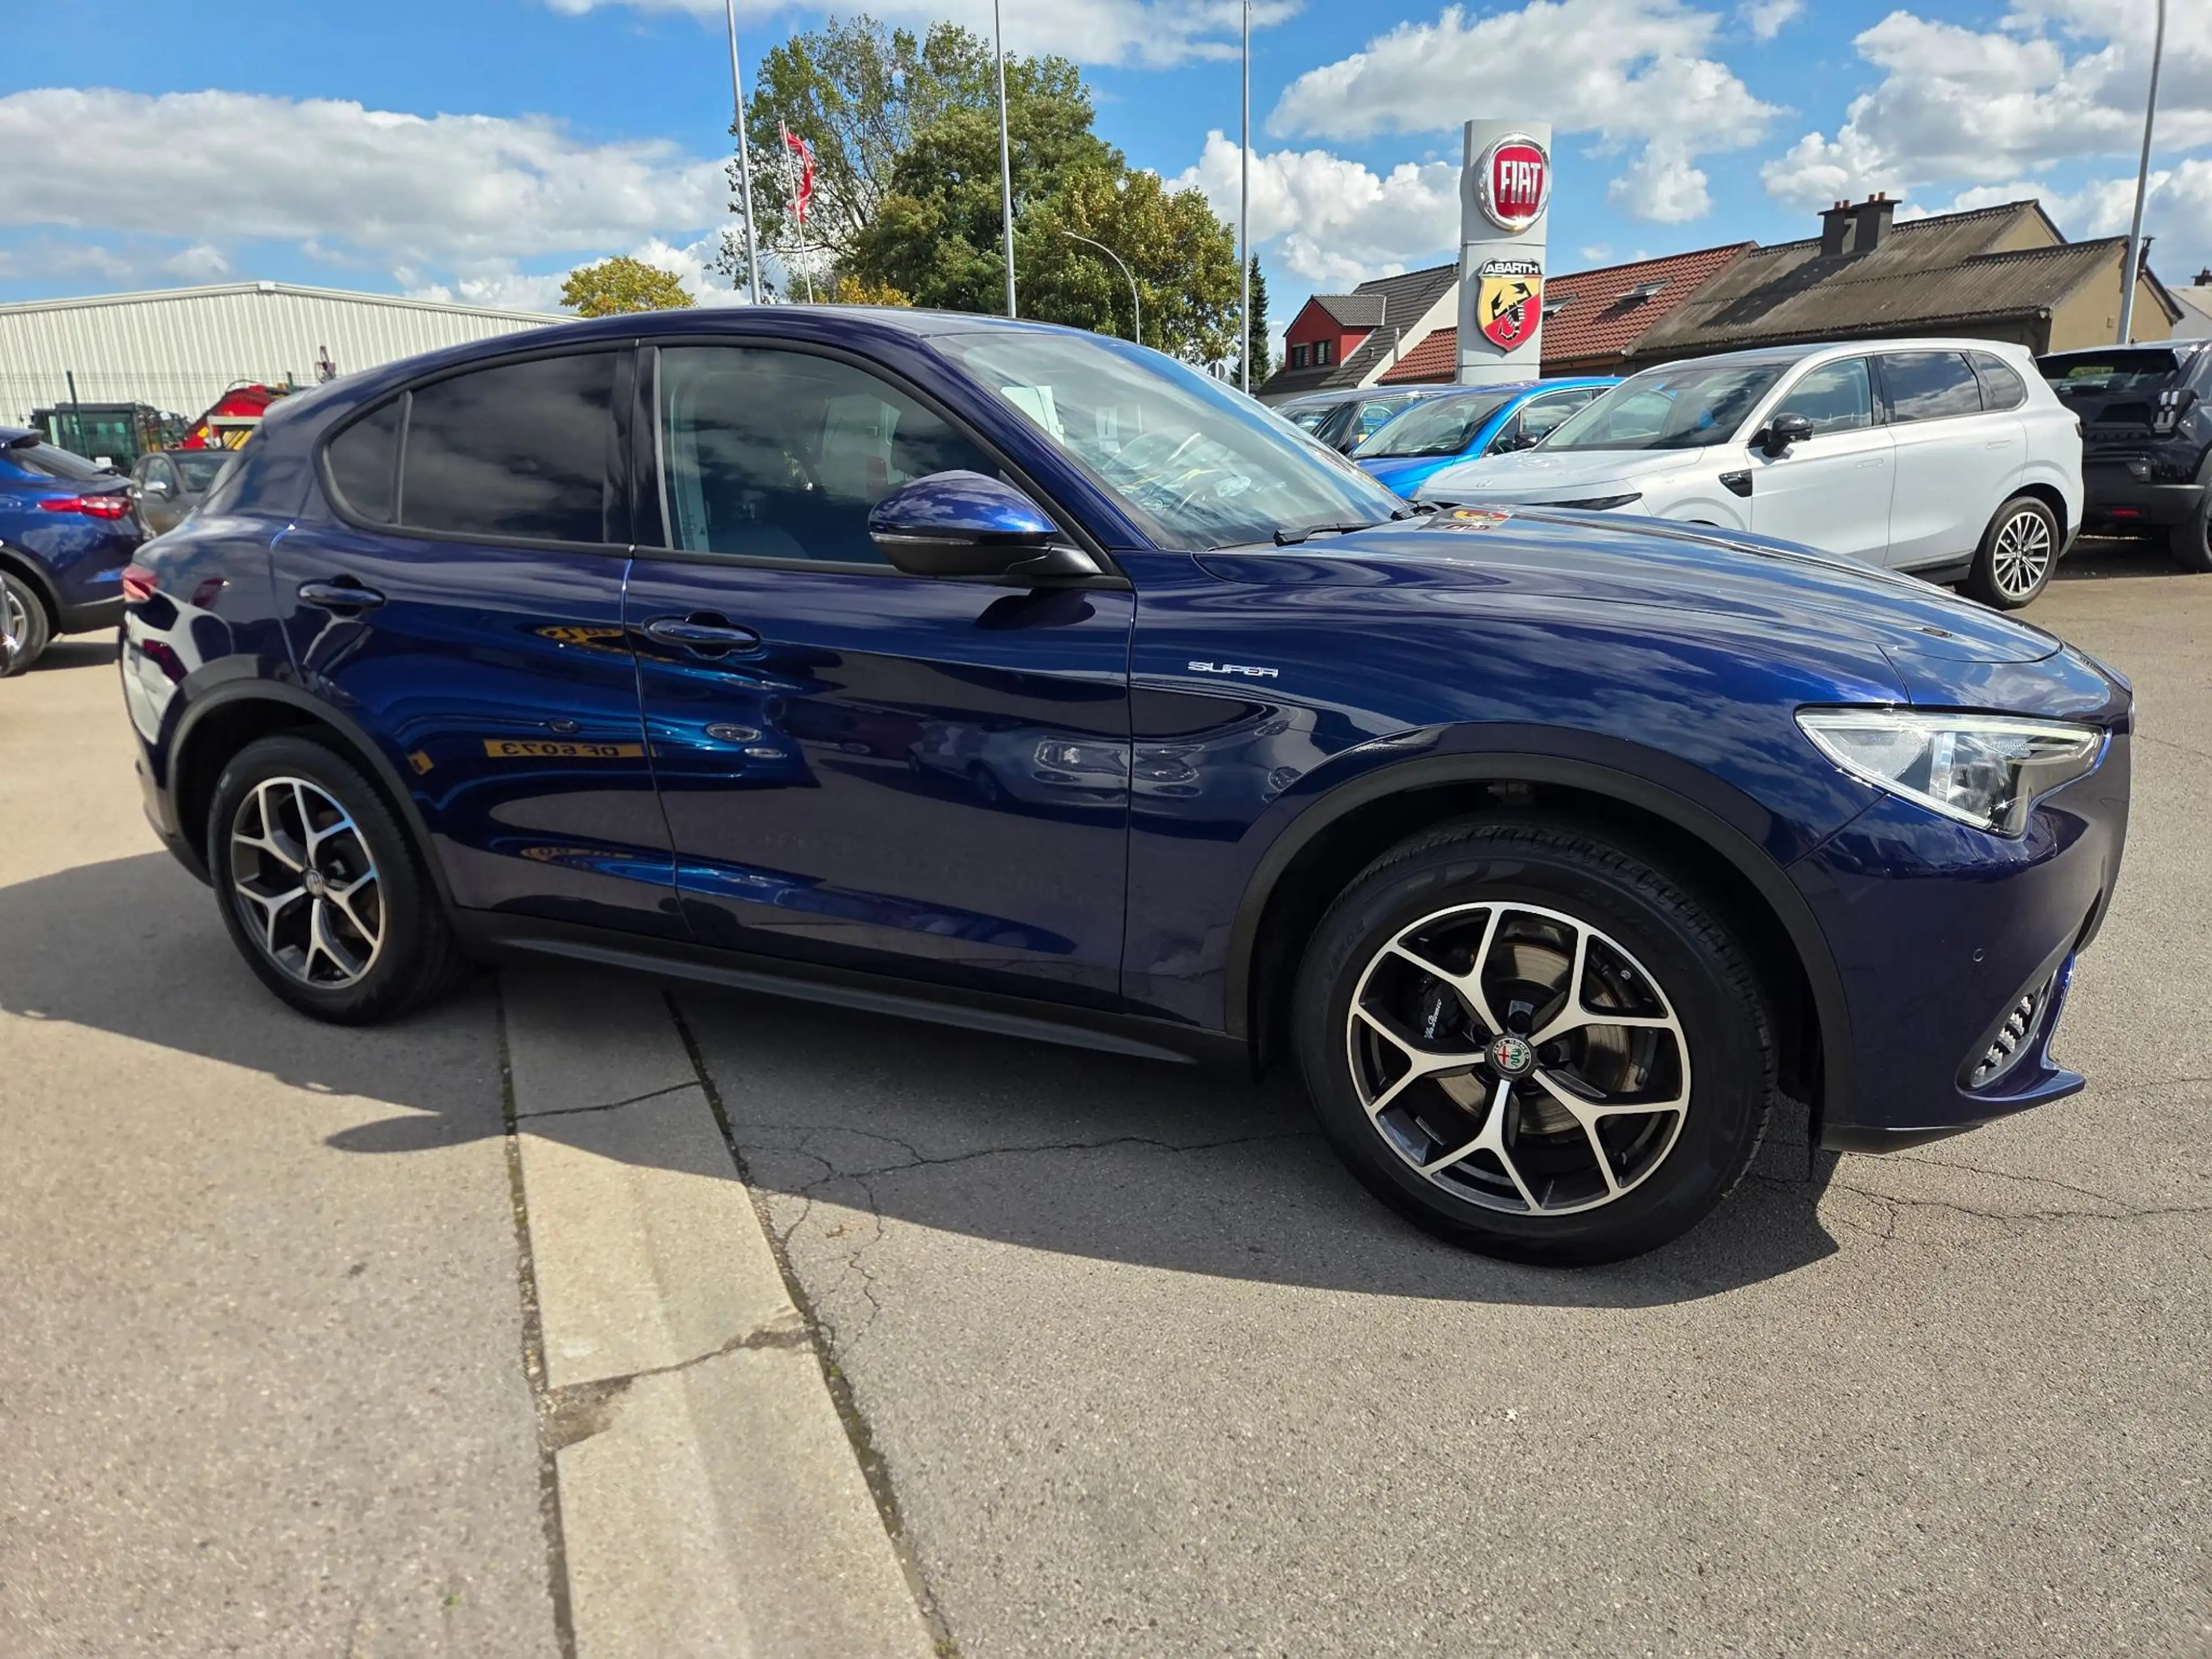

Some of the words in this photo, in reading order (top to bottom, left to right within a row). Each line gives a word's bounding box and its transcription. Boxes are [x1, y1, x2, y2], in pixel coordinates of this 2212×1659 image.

[1499, 160, 1541, 204] FIAT
[1485, 262, 1539, 274] ABARTH
[1188, 661, 1279, 678] SUPER
